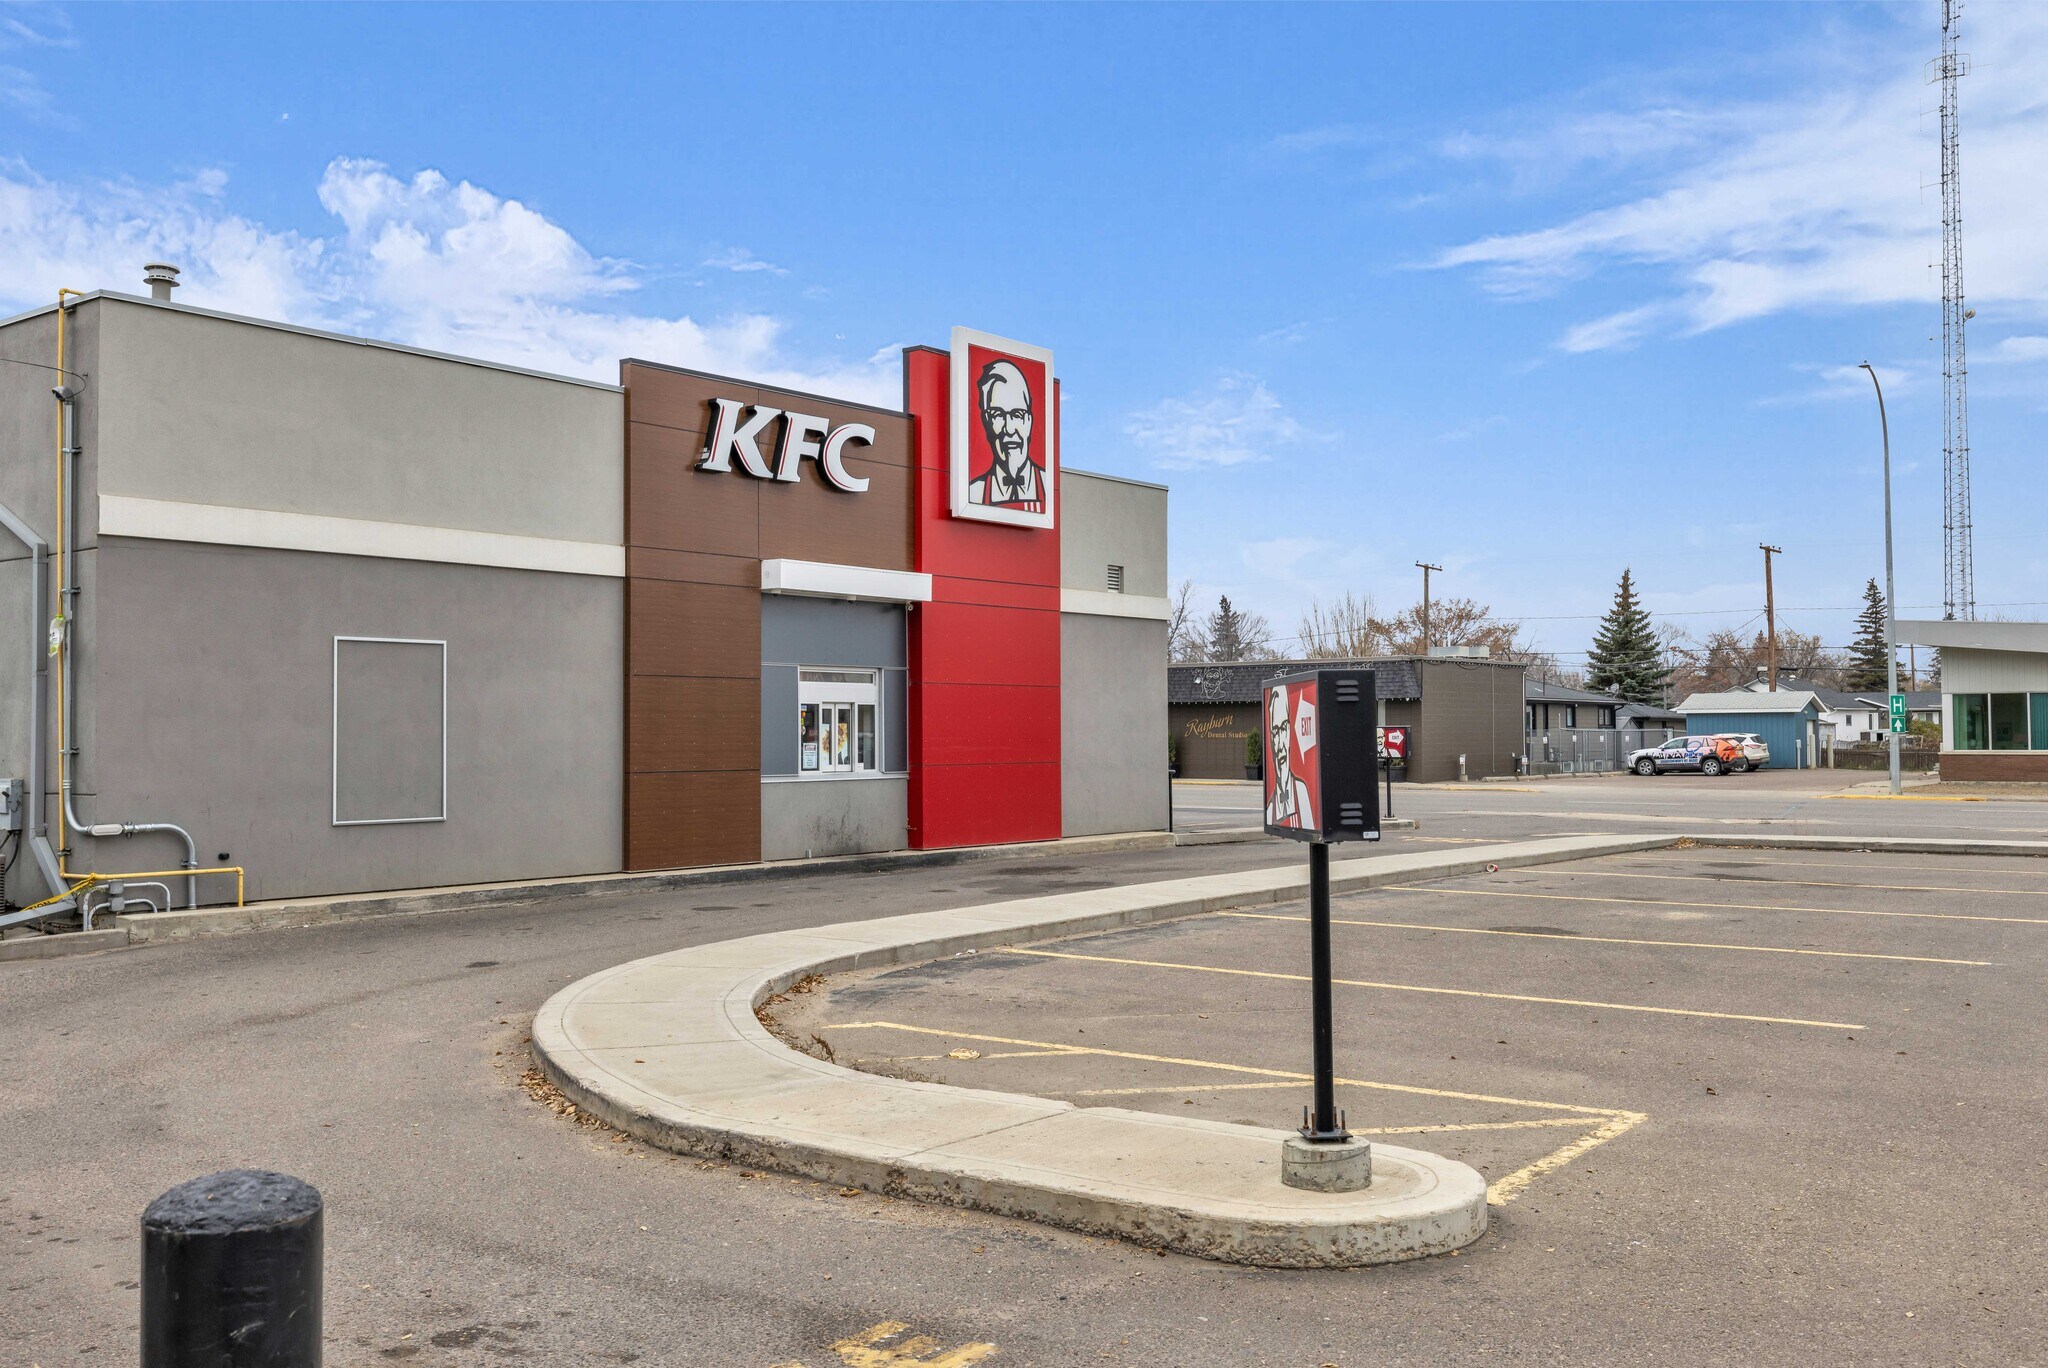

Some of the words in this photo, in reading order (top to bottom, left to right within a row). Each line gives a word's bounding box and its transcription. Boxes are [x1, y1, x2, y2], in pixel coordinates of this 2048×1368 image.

[698, 397, 876, 492] KFC
[1893, 698, 1903, 713] H
[1184, 714, 1235, 739] Rayburn
[1301, 717, 1312, 737] EXIT
